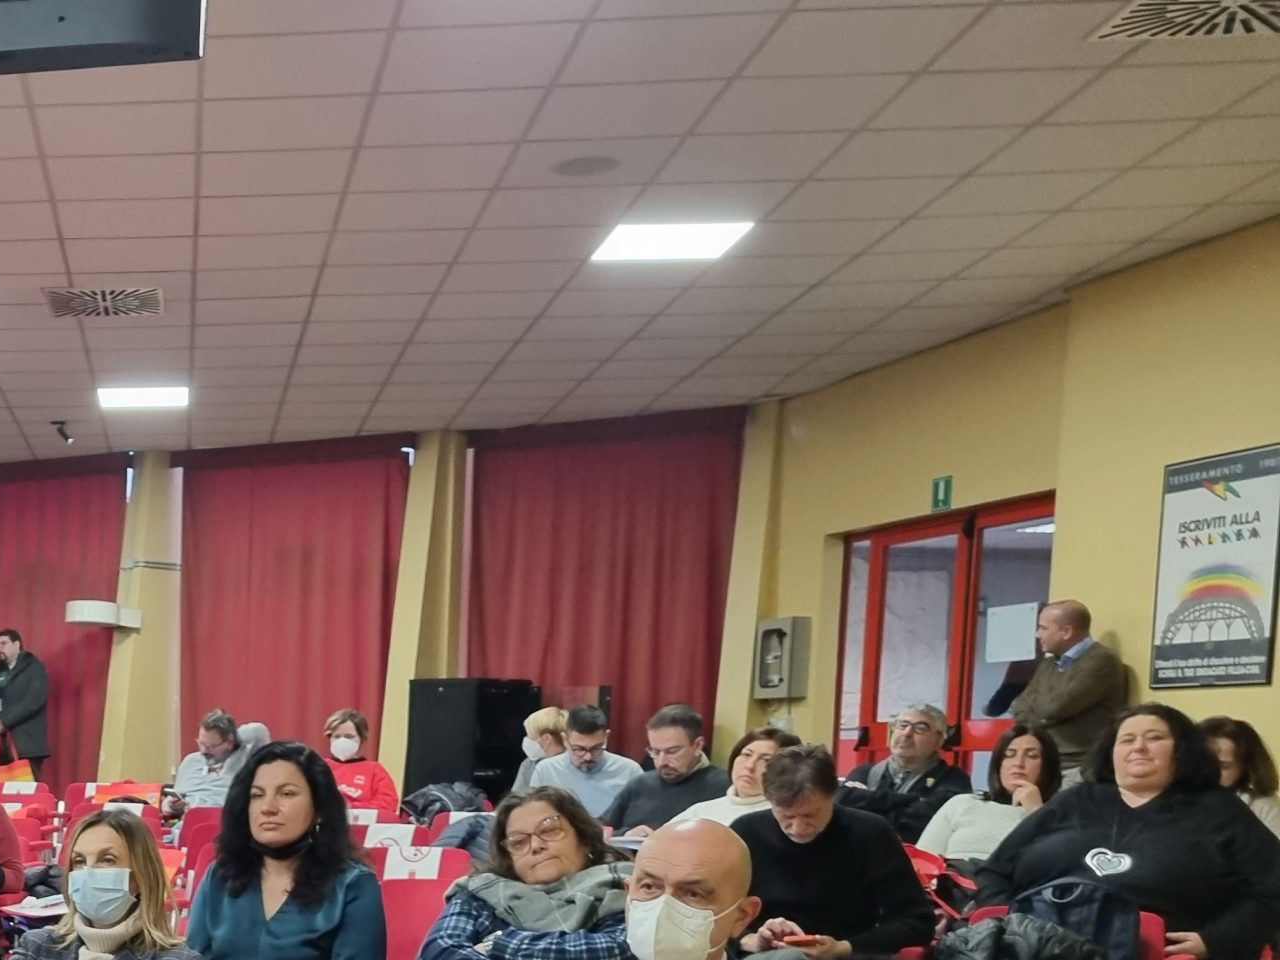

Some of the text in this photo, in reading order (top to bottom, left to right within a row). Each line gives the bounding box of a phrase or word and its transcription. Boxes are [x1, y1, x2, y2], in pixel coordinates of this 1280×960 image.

[1169, 464, 1243, 485] TESSERAMENTO
[1178, 510, 1260, 534] ISCRIVITI ALLA
